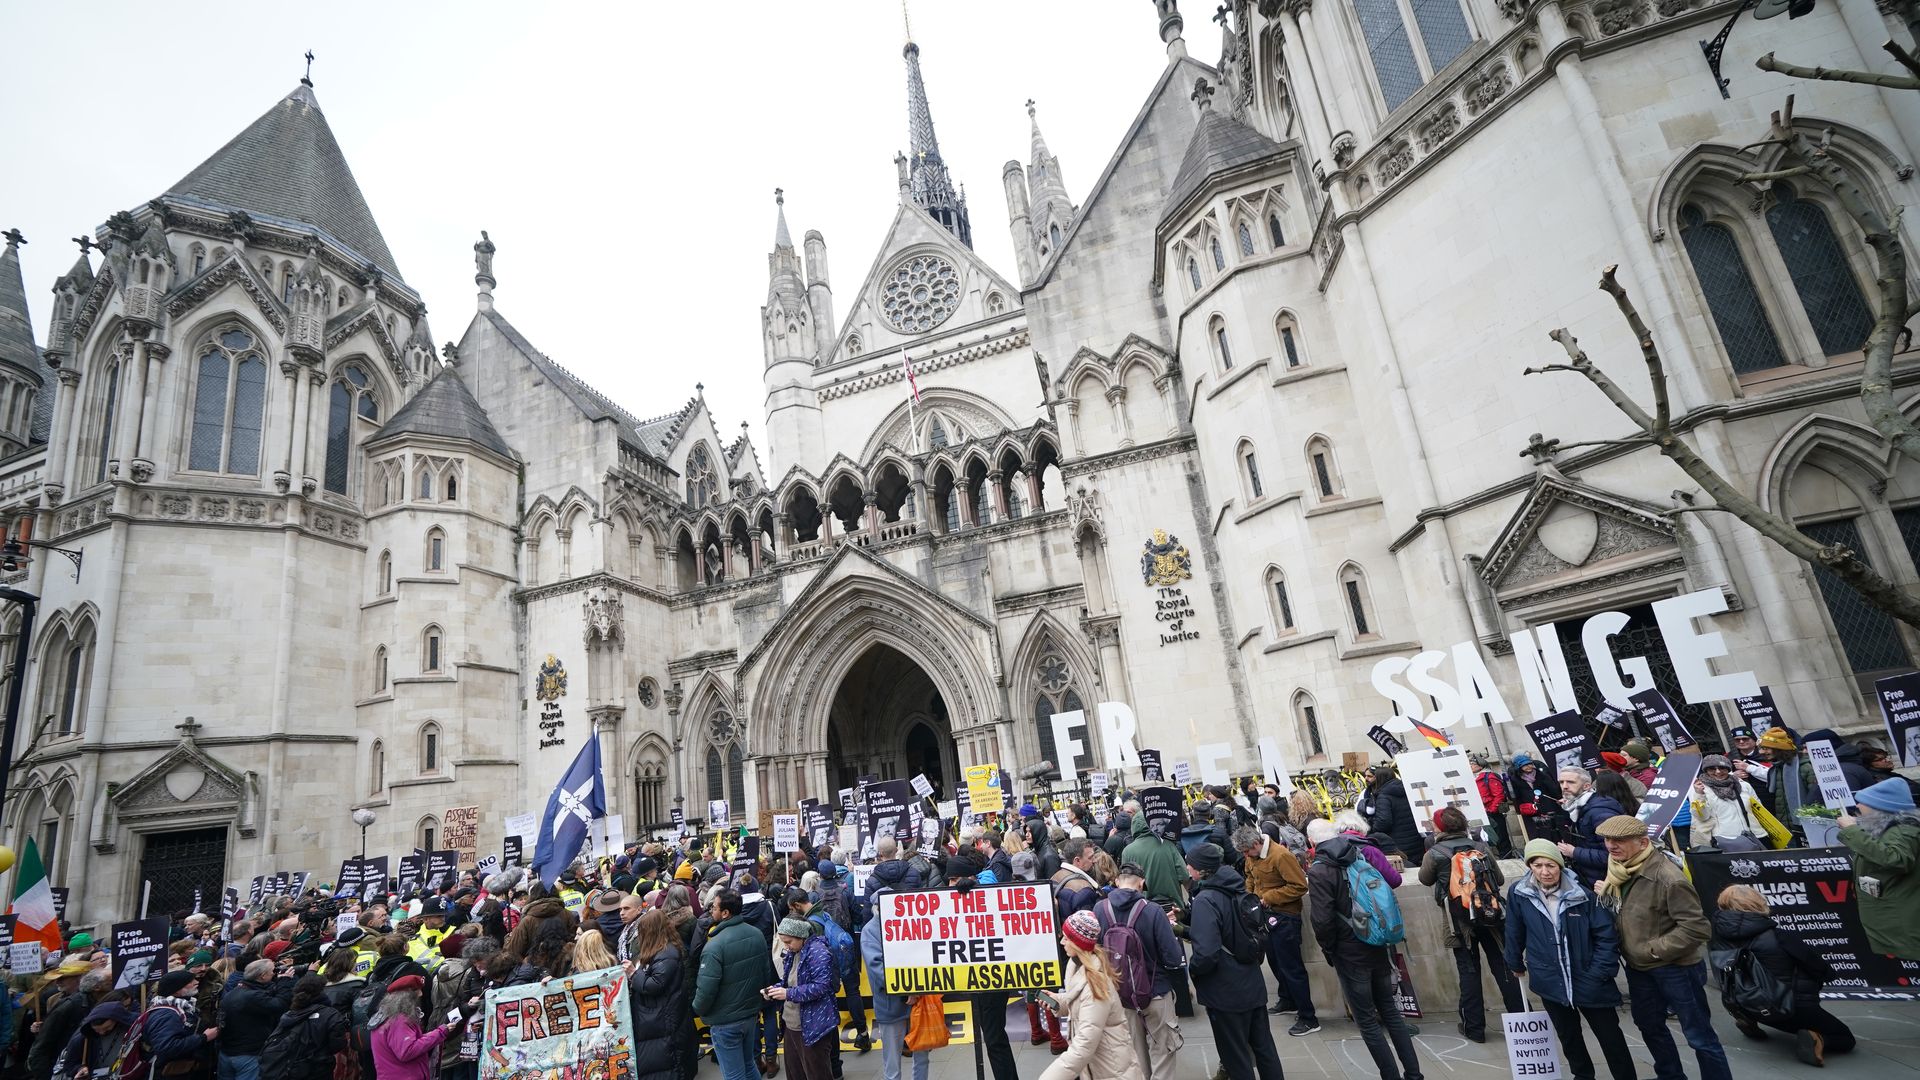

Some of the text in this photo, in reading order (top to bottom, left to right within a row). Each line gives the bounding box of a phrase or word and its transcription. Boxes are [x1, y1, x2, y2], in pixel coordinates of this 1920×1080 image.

[1157, 587, 1182, 599] The
[1155, 595, 1190, 612] Royal
[1155, 608, 1195, 622] Courts
[1169, 619, 1184, 631] of
[1160, 630, 1200, 647] Justice
[1737, 696, 1754, 704] Free
[1884, 690, 1905, 701] Free
[544, 702, 559, 711] The
[1635, 702, 1647, 710] Free
[1740, 702, 1762, 710] Julian
[1744, 706, 1773, 716] Assange
[1890, 699, 1918, 712] Julian
[541, 710, 563, 721] Royal
[1894, 711, 1920, 724] Assan
[539, 720, 565, 732] Courts
[1534, 725, 1556, 737] Free
[547, 728, 556, 738] of
[1537, 730, 1568, 745] Julian
[539, 738, 565, 750] Justice
[1544, 734, 1585, 752] Assange
[1811, 747, 1834, 759] FREE
[1819, 763, 1838, 773] JULIAN
[1822, 776, 1842, 784] ASSANGE
[870, 791, 887, 799] Free
[1145, 795, 1161, 803] Free
[1647, 788, 1680, 799] ange
[1825, 788, 1850, 801] NOW!
[871, 798, 894, 808] Julian
[1145, 801, 1168, 811] Julian
[445, 807, 478, 823] ASSANGE
[872, 804, 905, 815] Assange
[1145, 809, 1179, 818] Assange
[459, 820, 467, 828] TO
[811, 820, 833, 828] Assange
[505, 850, 521, 859] Assange
[478, 855, 497, 869] NO
[1762, 856, 1848, 868] ROYAL COURTS
[401, 869, 421, 877] Assange
[430, 865, 452, 873] Assange
[1783, 864, 1852, 874] OF JUSTICE
[893, 886, 1037, 917] STOP THE LIES
[1793, 911, 1840, 923] journalist
[884, 910, 1053, 942] STAND BY THE TRUTH
[1781, 921, 1843, 932] nd publisher
[117, 930, 143, 942] Free
[1802, 936, 1849, 947] mpaigner
[117, 936, 151, 948] Julian
[117, 943, 164, 957] Assange
[931, 937, 1006, 964] FREE
[1821, 952, 1856, 961] crimes
[356, 961, 371, 972] ICE
[1831, 961, 1861, 971] ption
[890, 961, 1056, 992] JULIAN ASSANGE
[495, 985, 604, 1047] FREE
[1508, 1020, 1549, 1033] NOW!
[1513, 1036, 1549, 1046] ASSANGE
[1516, 1047, 1551, 1058] JULIAN
[1517, 1061, 1555, 1075] FREE
